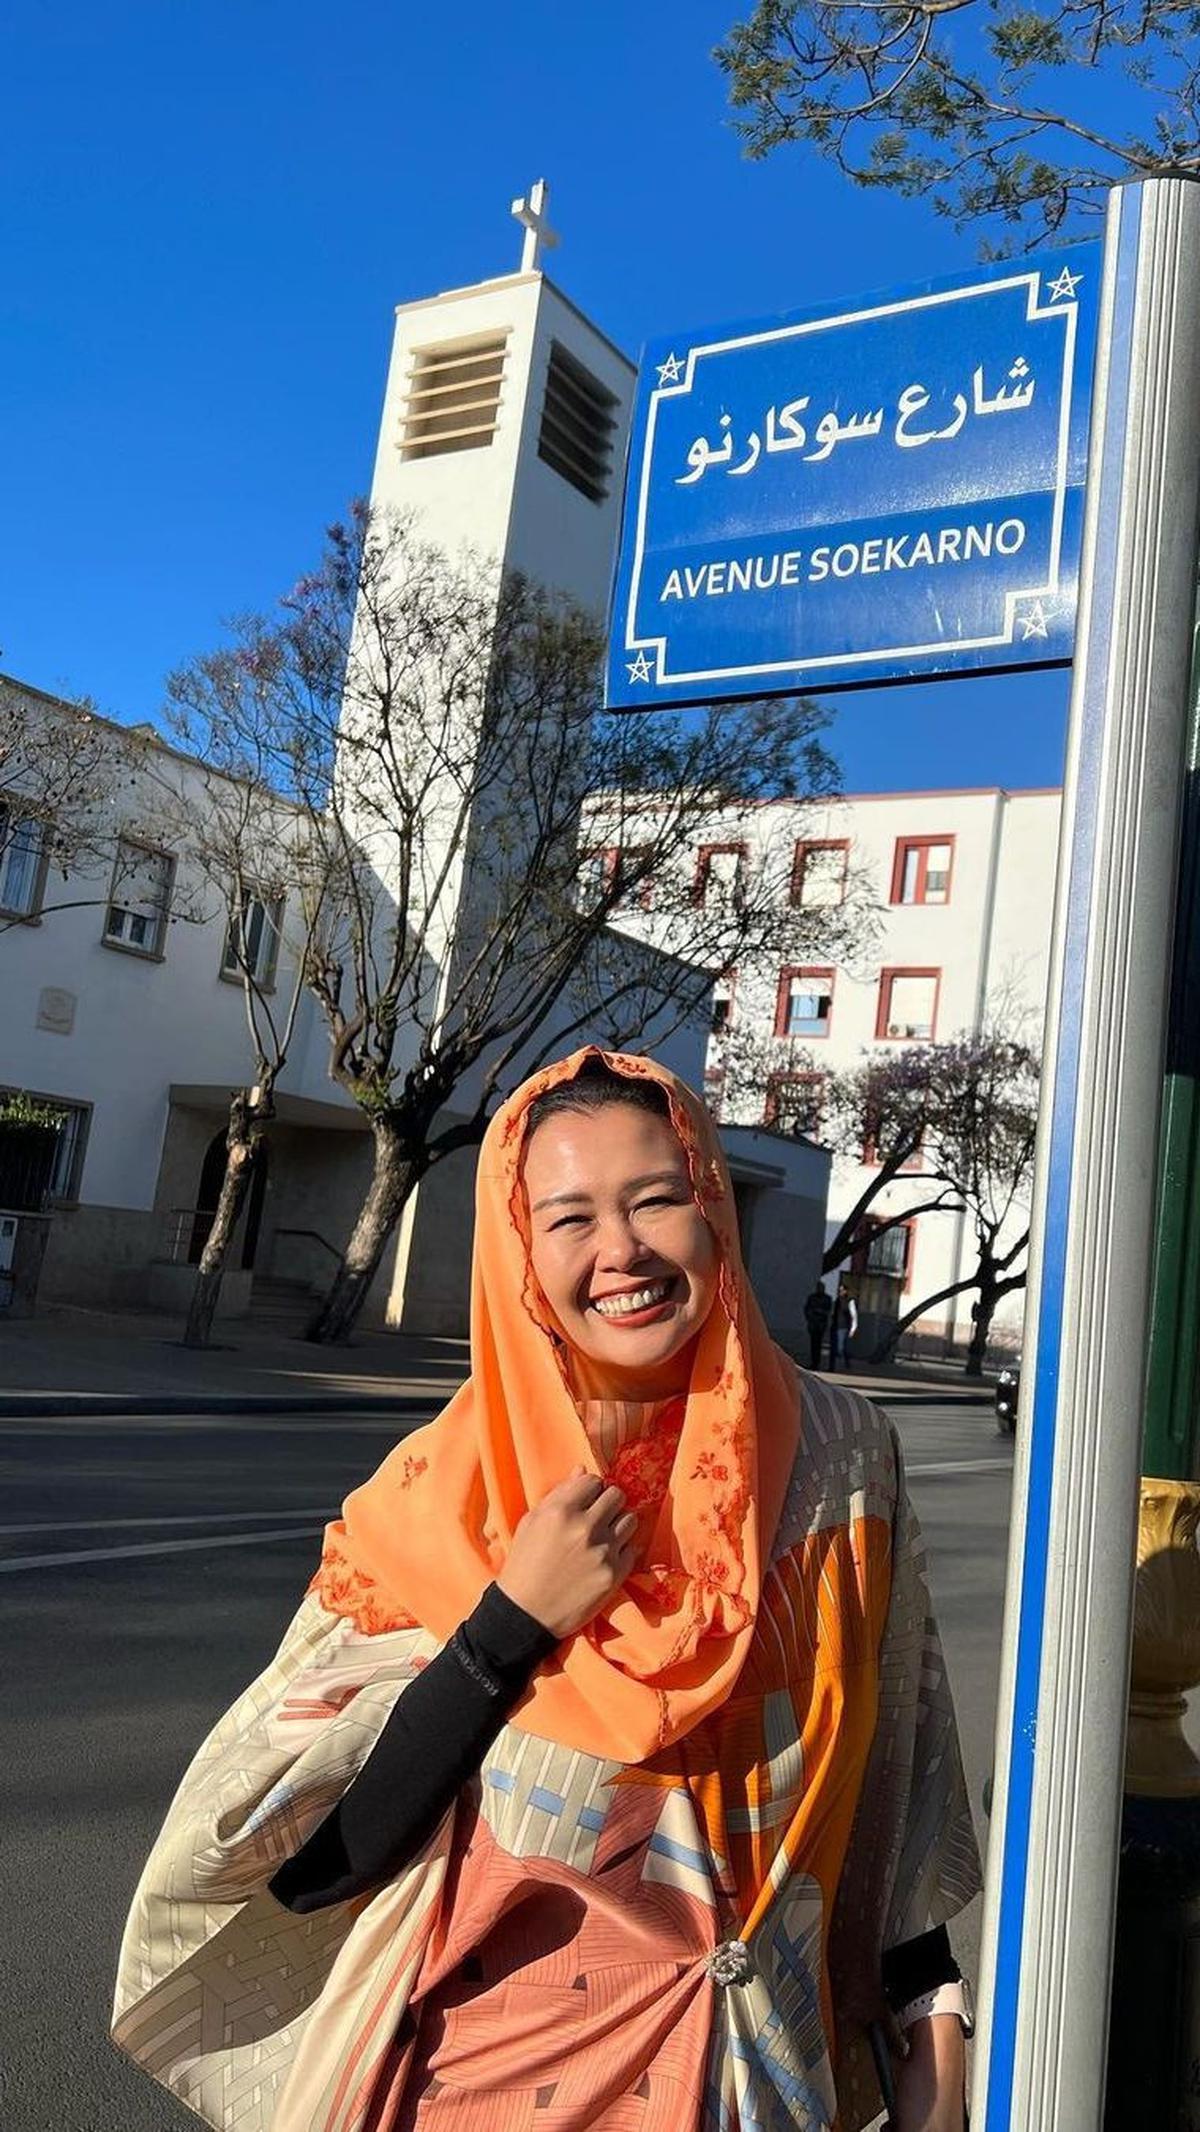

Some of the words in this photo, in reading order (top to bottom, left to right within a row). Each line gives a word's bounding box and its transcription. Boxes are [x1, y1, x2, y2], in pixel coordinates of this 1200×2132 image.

[675, 396, 885, 484] سوكارنو
[894, 356, 1036, 448] شارع
[660, 551, 801, 601] AVENUE
[807, 518, 1026, 582] SOEKARNO
